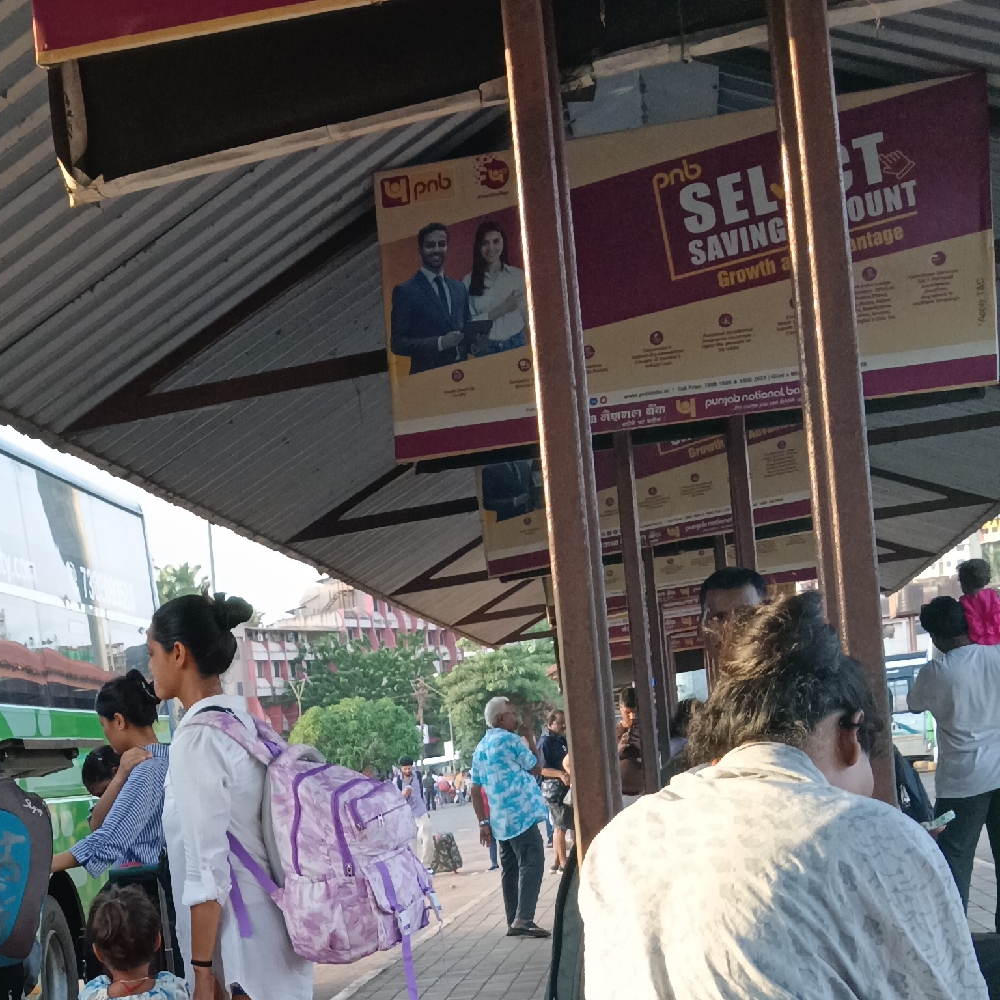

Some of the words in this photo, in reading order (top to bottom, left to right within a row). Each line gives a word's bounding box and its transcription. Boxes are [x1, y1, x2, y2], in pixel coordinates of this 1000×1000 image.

[413, 171, 452, 201] pnb
[652, 159, 702, 189] pnb
[688, 216, 788, 266] SAVING
[716, 254, 777, 289] Growth
[704, 392, 741, 410] punjab
[741, 386, 786, 402] national
